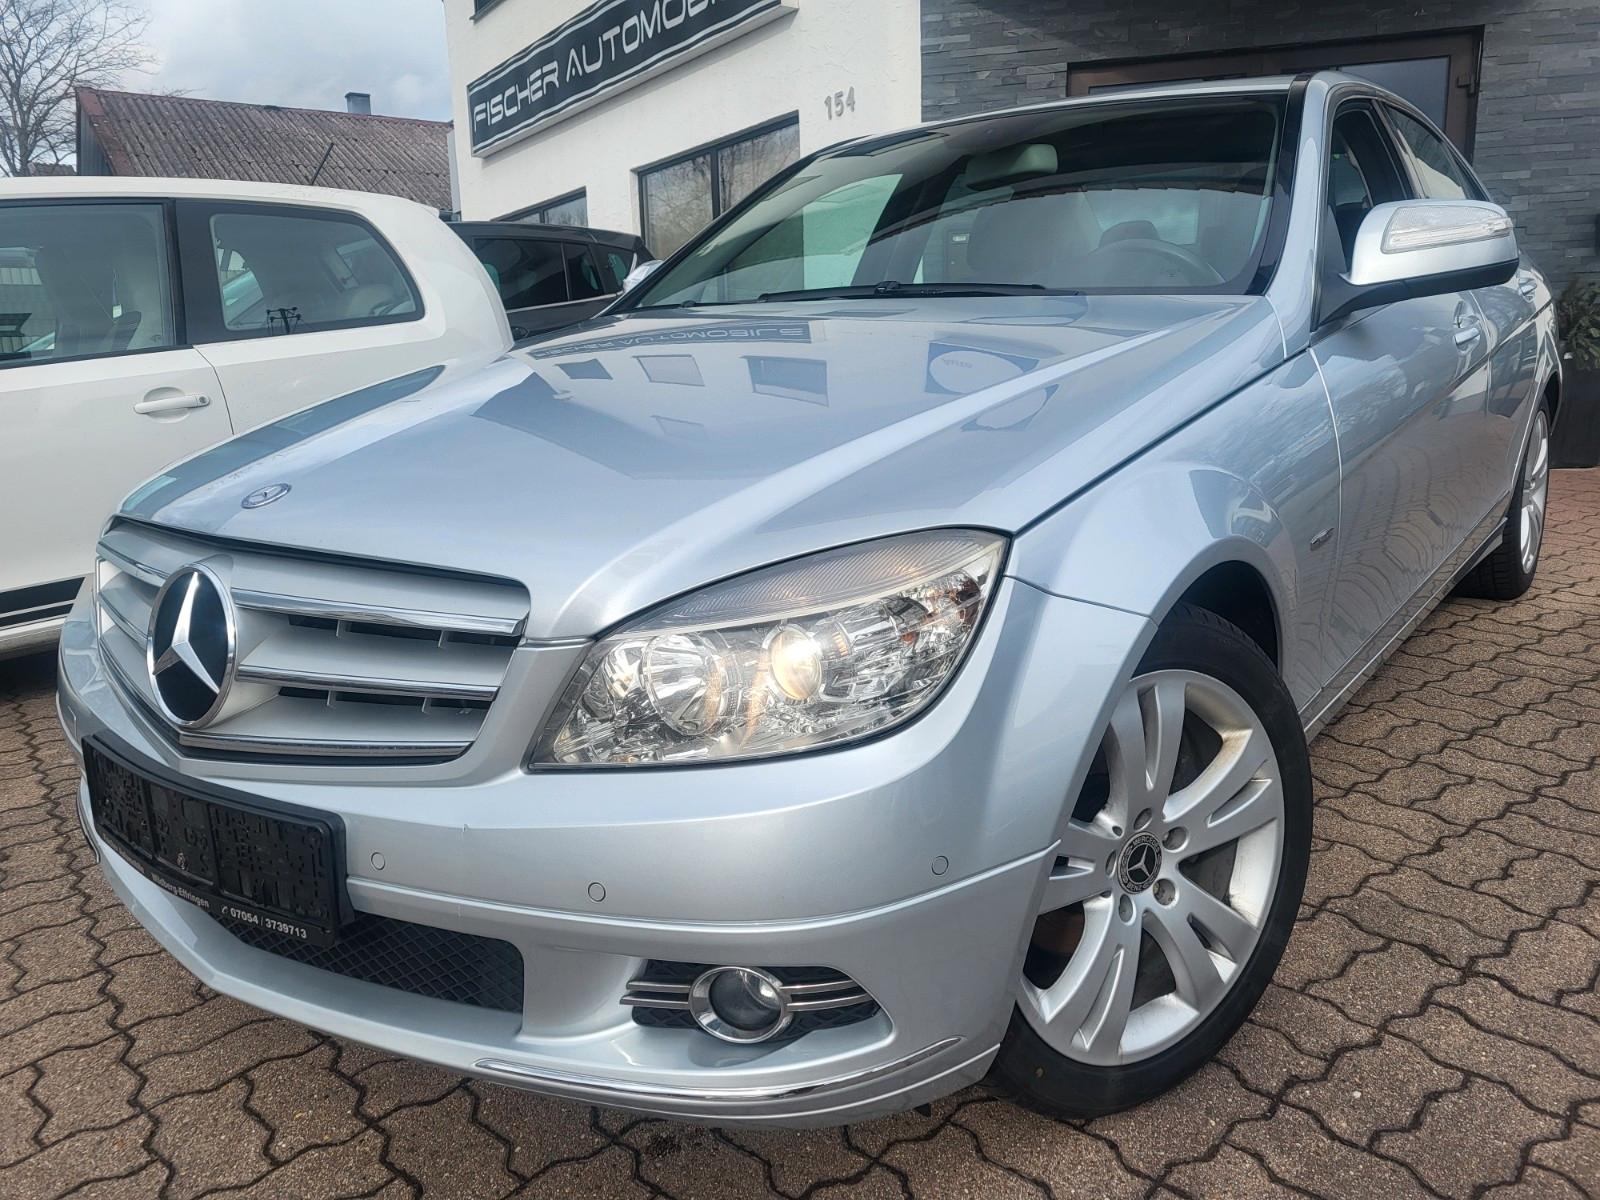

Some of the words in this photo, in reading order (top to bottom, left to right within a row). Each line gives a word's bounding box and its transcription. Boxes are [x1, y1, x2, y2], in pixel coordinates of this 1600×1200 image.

[473, 60, 559, 133] FISCHER
[566, 0, 716, 84] AUTOMOB
[824, 86, 855, 120] 154
[230, 908, 259, 924] 07054
[265, 918, 307, 939] 3739713
